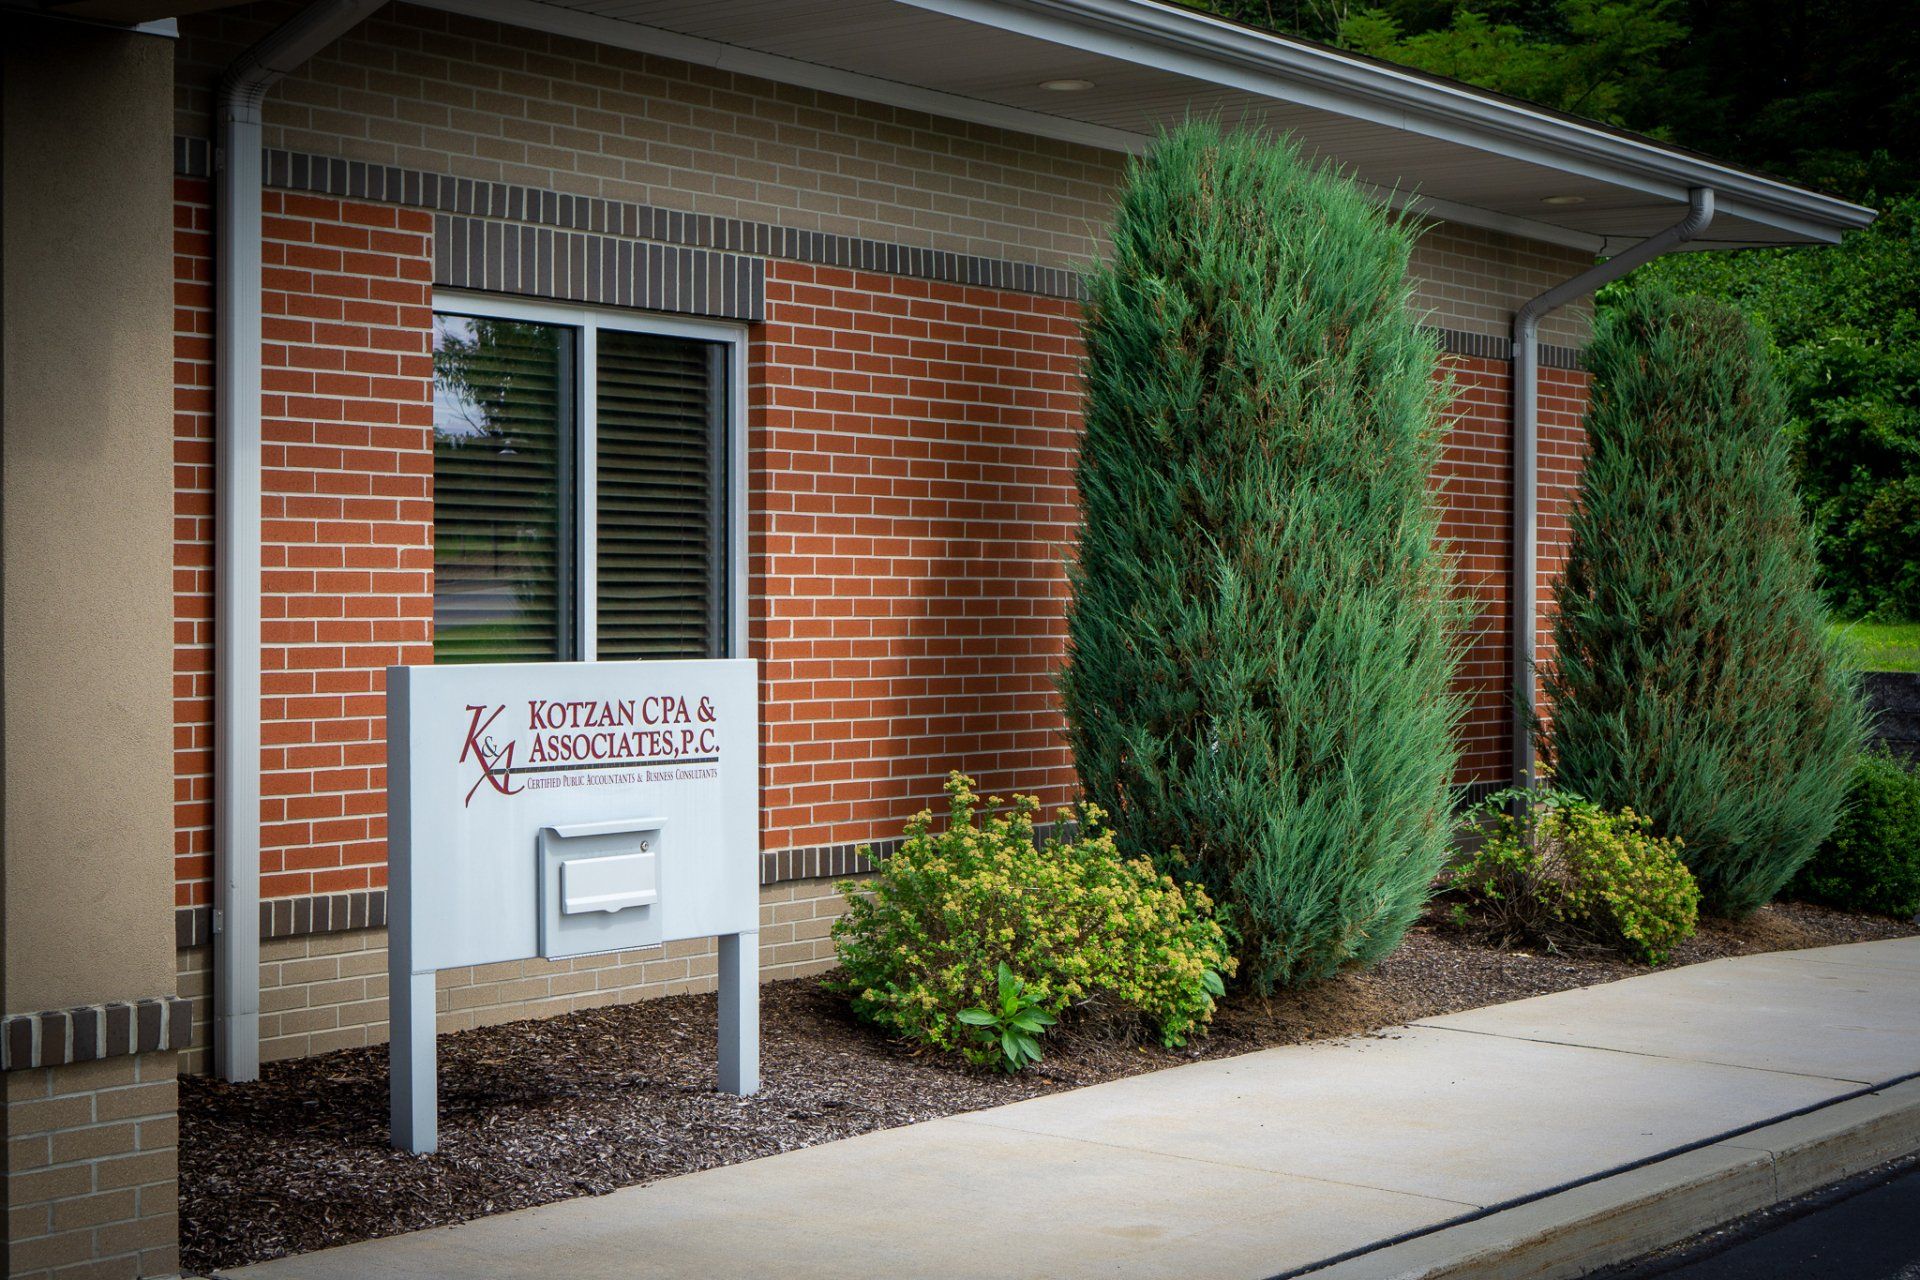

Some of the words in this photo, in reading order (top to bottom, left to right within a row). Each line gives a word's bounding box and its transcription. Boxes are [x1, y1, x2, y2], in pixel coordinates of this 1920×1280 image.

[528, 700, 635, 730] KOTZAN
[642, 695, 691, 725] CPA
[697, 696, 717, 722] &
[527, 777, 561, 789] CERTIFIED
[563, 775, 584, 787] PUBLIC
[587, 772, 635, 786] ACCOUNTANTS
[637, 774, 642, 783] &
[646, 771, 673, 782] BUSINESS
[675, 768, 717, 780] CONSULTANTS
